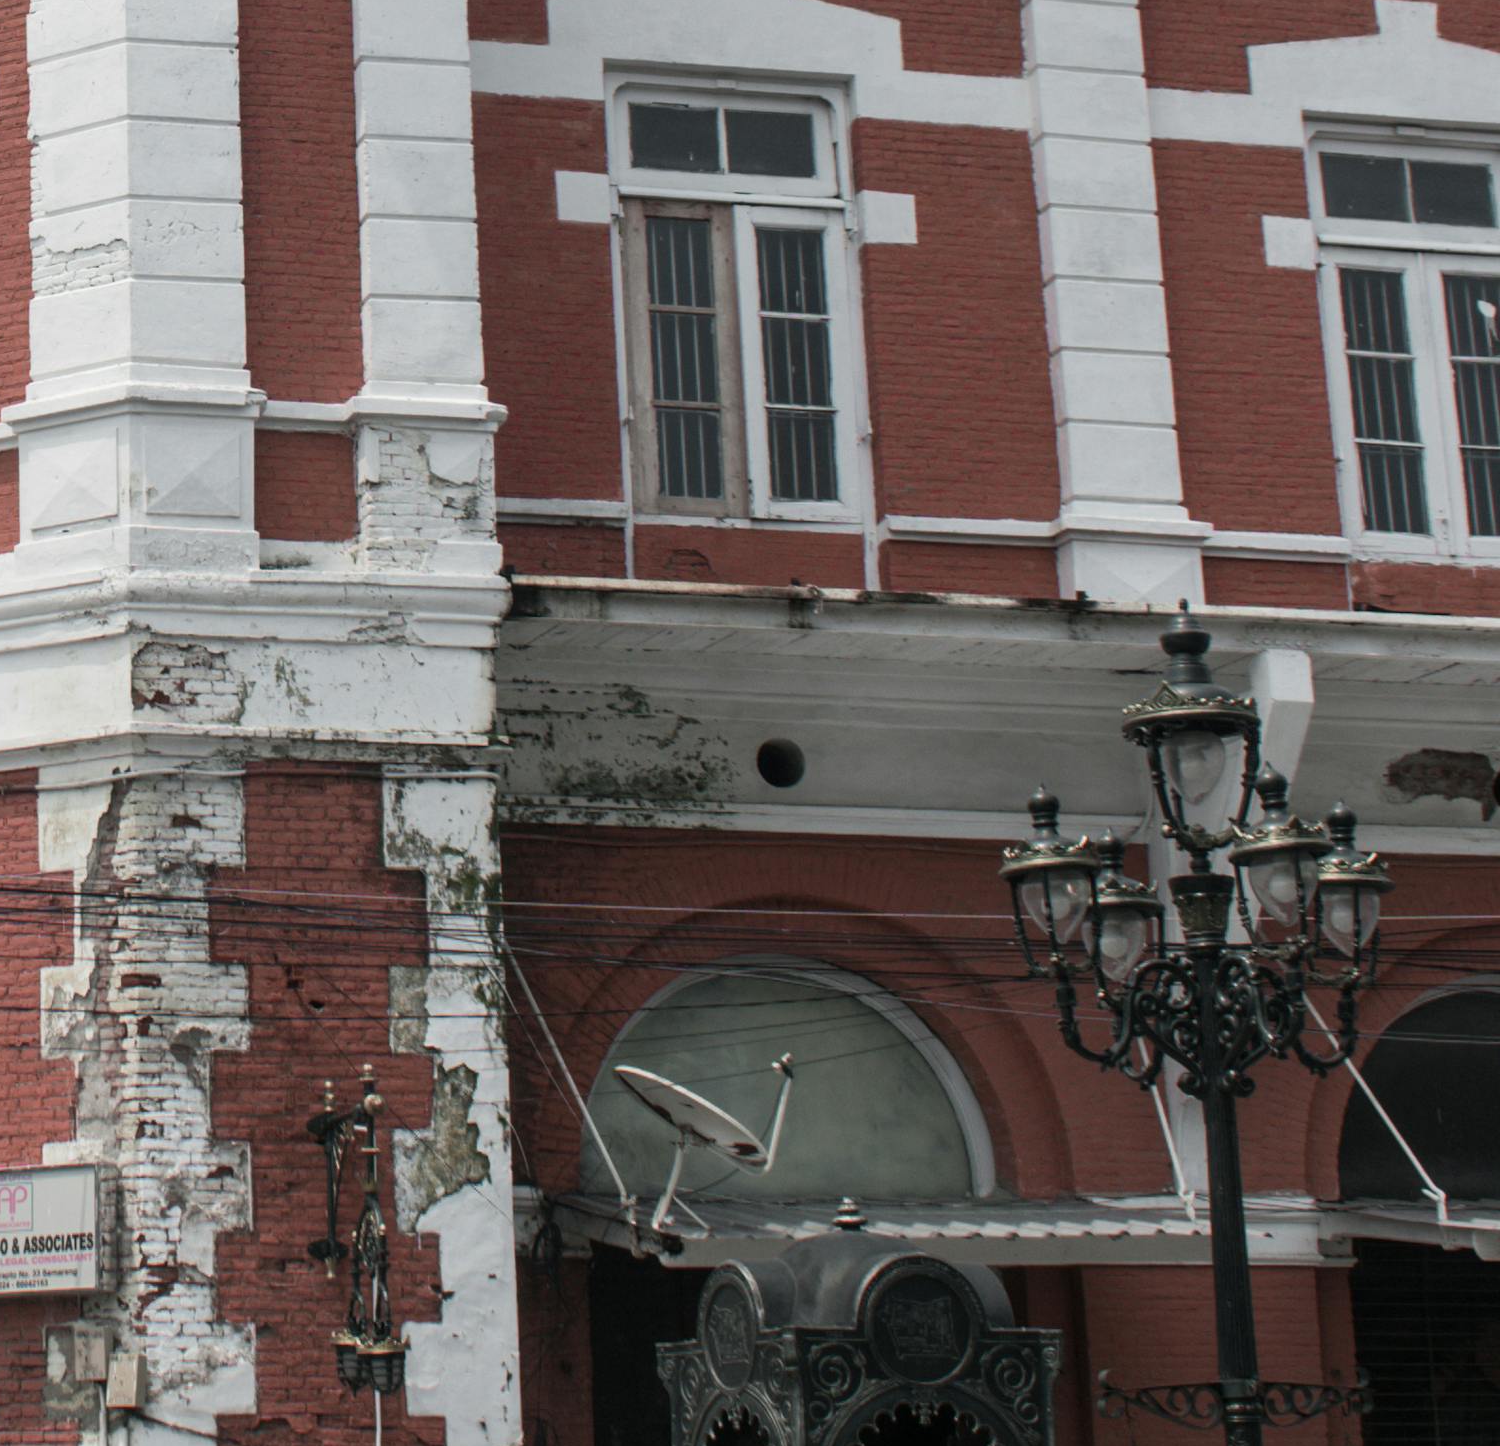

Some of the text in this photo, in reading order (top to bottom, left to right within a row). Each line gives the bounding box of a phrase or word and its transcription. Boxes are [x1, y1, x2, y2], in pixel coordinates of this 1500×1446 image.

[11, 1237, 20, 1255] &
[23, 1232, 94, 1254] ASSOCIATES
[0, 1256, 28, 1266] LEGAL
[31, 1253, 93, 1264] CONSULTANT
